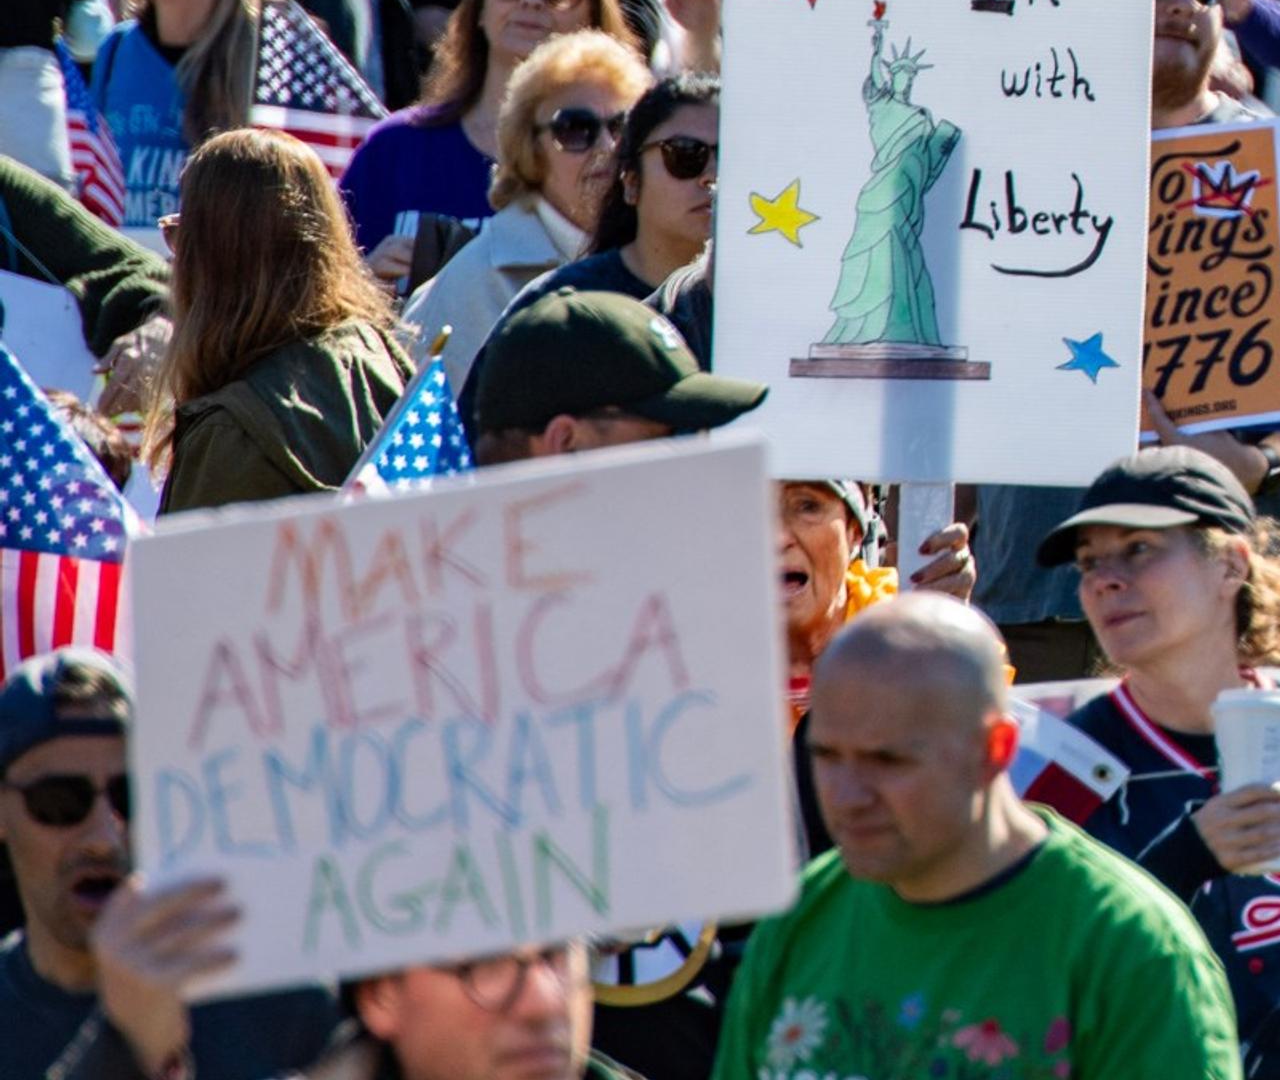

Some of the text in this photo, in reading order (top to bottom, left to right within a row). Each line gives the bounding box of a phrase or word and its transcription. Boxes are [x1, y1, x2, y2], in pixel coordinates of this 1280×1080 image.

[1001, 47, 1096, 101] with
[959, 168, 1115, 278] Liberty
[1146, 262, 1272, 329] ince
[265, 482, 594, 618] MAKE
[188, 590, 692, 749] AMERICA
[154, 688, 756, 865] DEMOCRATIC
[302, 801, 611, 955] AGAIN
